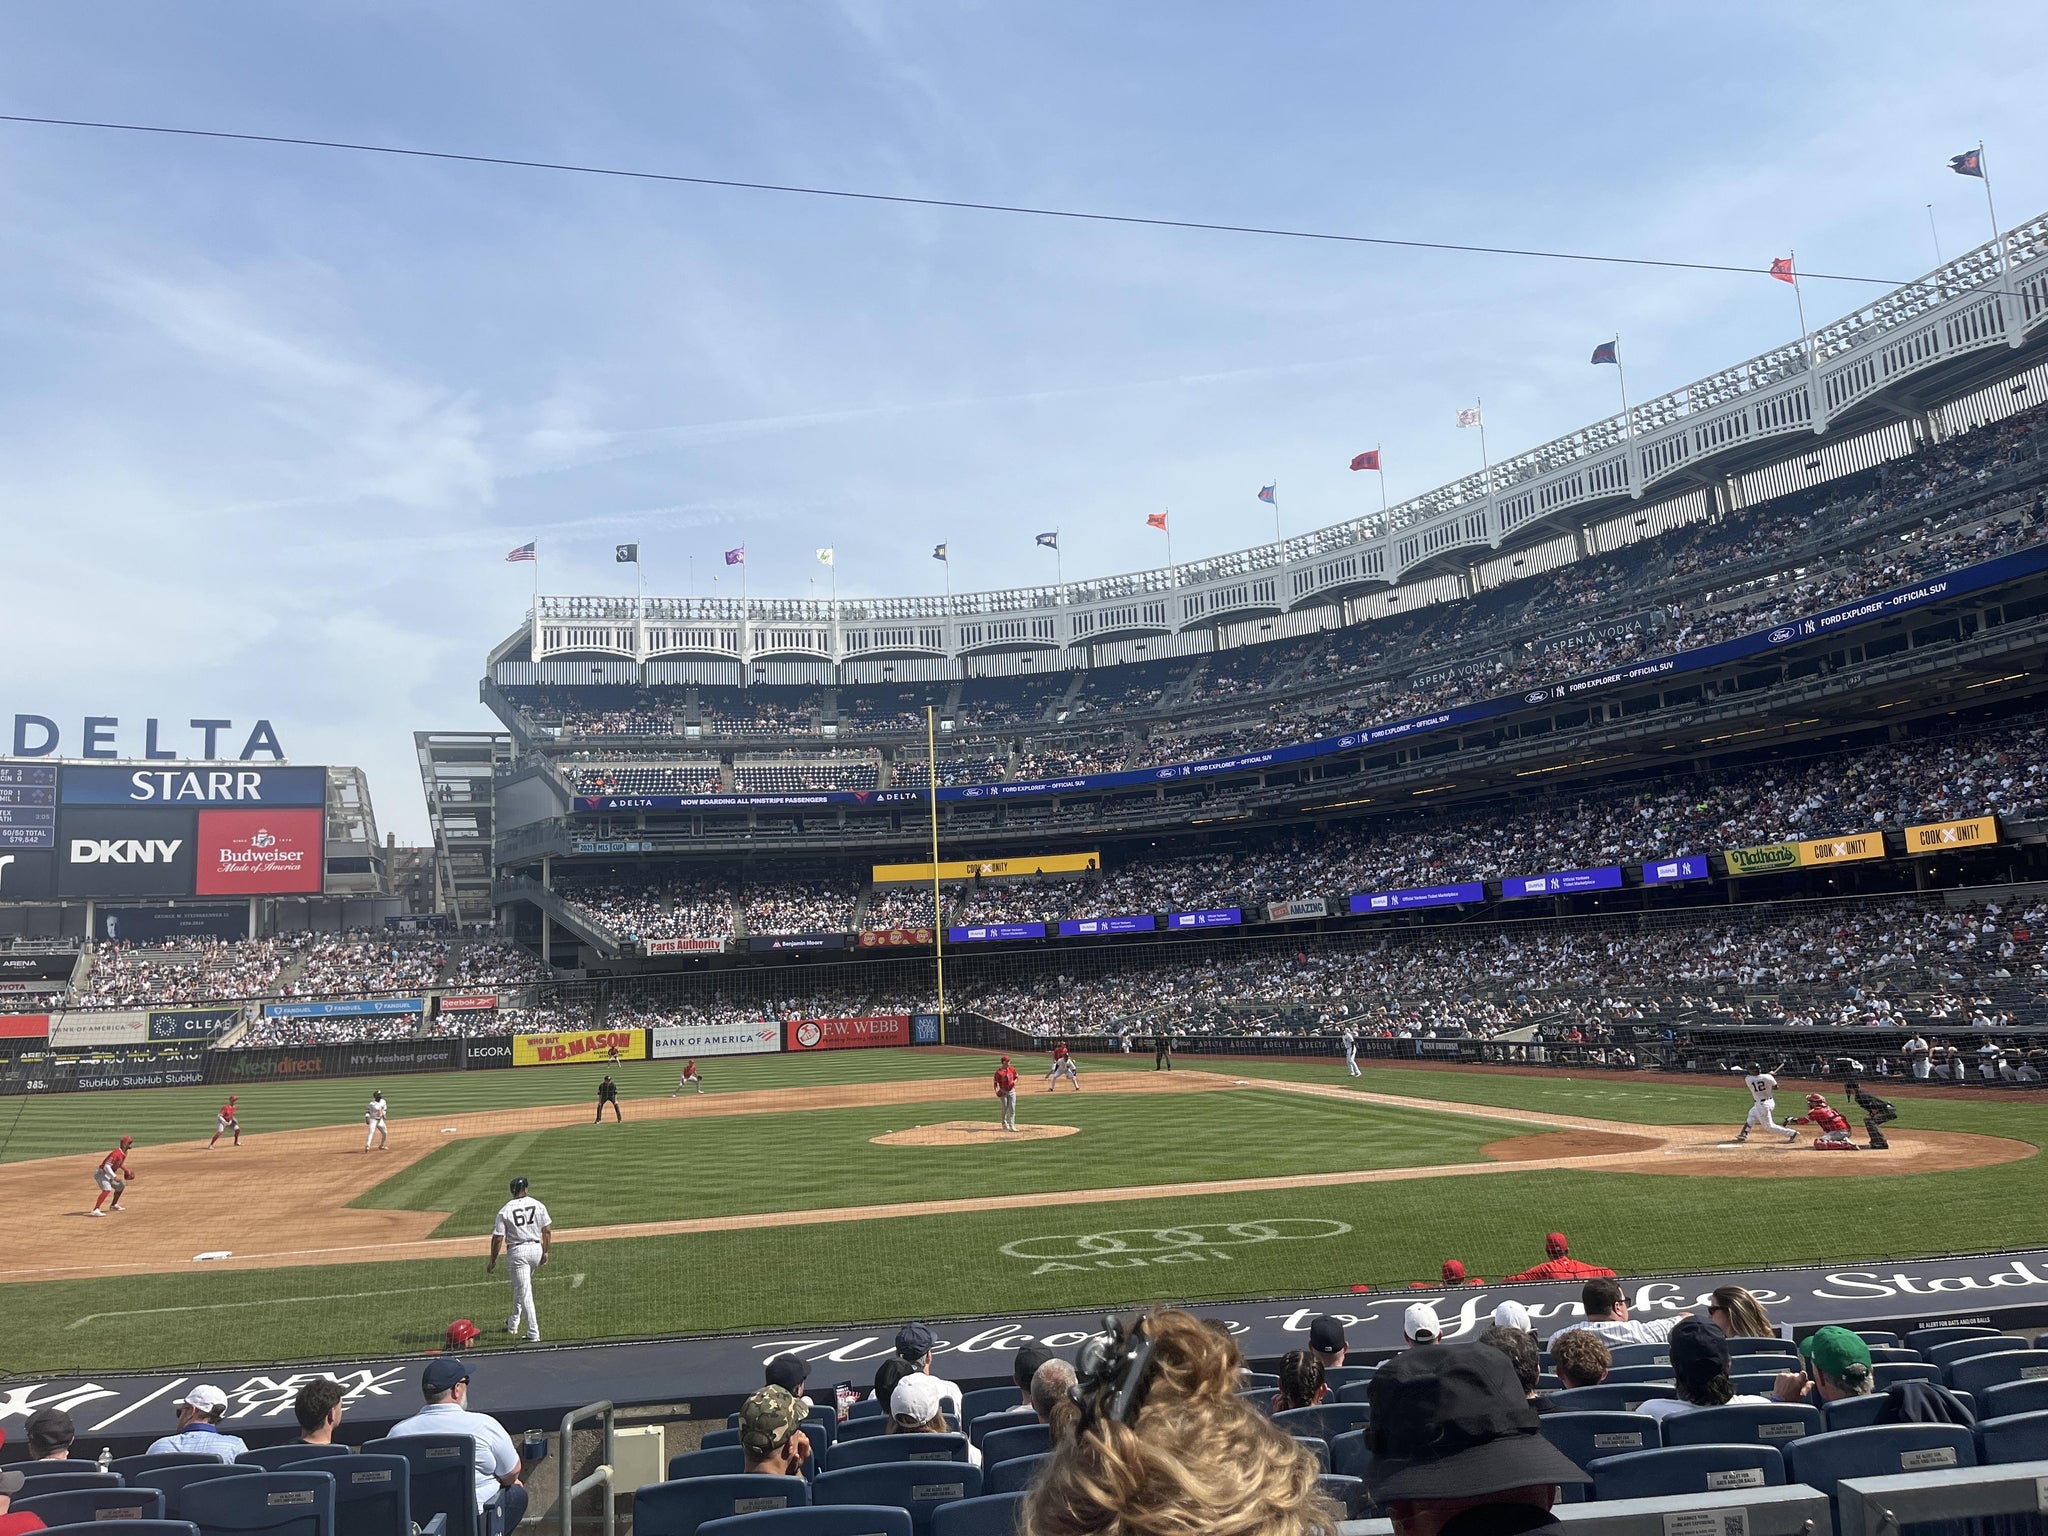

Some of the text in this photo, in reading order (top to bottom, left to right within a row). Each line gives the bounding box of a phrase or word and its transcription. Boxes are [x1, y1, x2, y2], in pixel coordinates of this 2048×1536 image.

[1821, 614, 1841, 626] FORD
[1893, 588, 1929, 605] OFFICIAL
[1930, 582, 1946, 594] SUV
[1544, 620, 1642, 652] ASPEN VODKA
[1412, 660, 1494, 689] ASPEN VODKA
[1570, 682, 1586, 692] FORD
[1629, 666, 1659, 678] OFFICIAL
[1660, 661, 1674, 671] SUV
[13, 714, 285, 760] DELTA
[1372, 730, 1384, 738] FORD
[1416, 718, 1438, 728] OFFICIAL
[130, 770, 262, 800] STARR
[1920, 824, 1979, 846] COOK UNITY
[70, 839, 182, 864] DKNY
[219, 849, 304, 862] Budweiser
[1731, 846, 1796, 866] Nathan's
[1814, 839, 1866, 858] COOK UNITY
[217, 862, 301, 874] Made of America
[1290, 902, 1323, 915] AMAZING
[651, 939, 720, 950] Parts Authority
[823, 1020, 899, 1035] F.W. WEBB
[655, 1038, 685, 1047] BANK
[704, 1035, 754, 1044] AMERICA
[351, 1052, 448, 1065] NY's freshest grocer
[468, 1047, 511, 1057] LEGORA
[79, 1073, 203, 1088] StubHub StubHub StubHub
[1752, 1081, 1766, 1092] 12
[512, 1206, 536, 1227] 67
